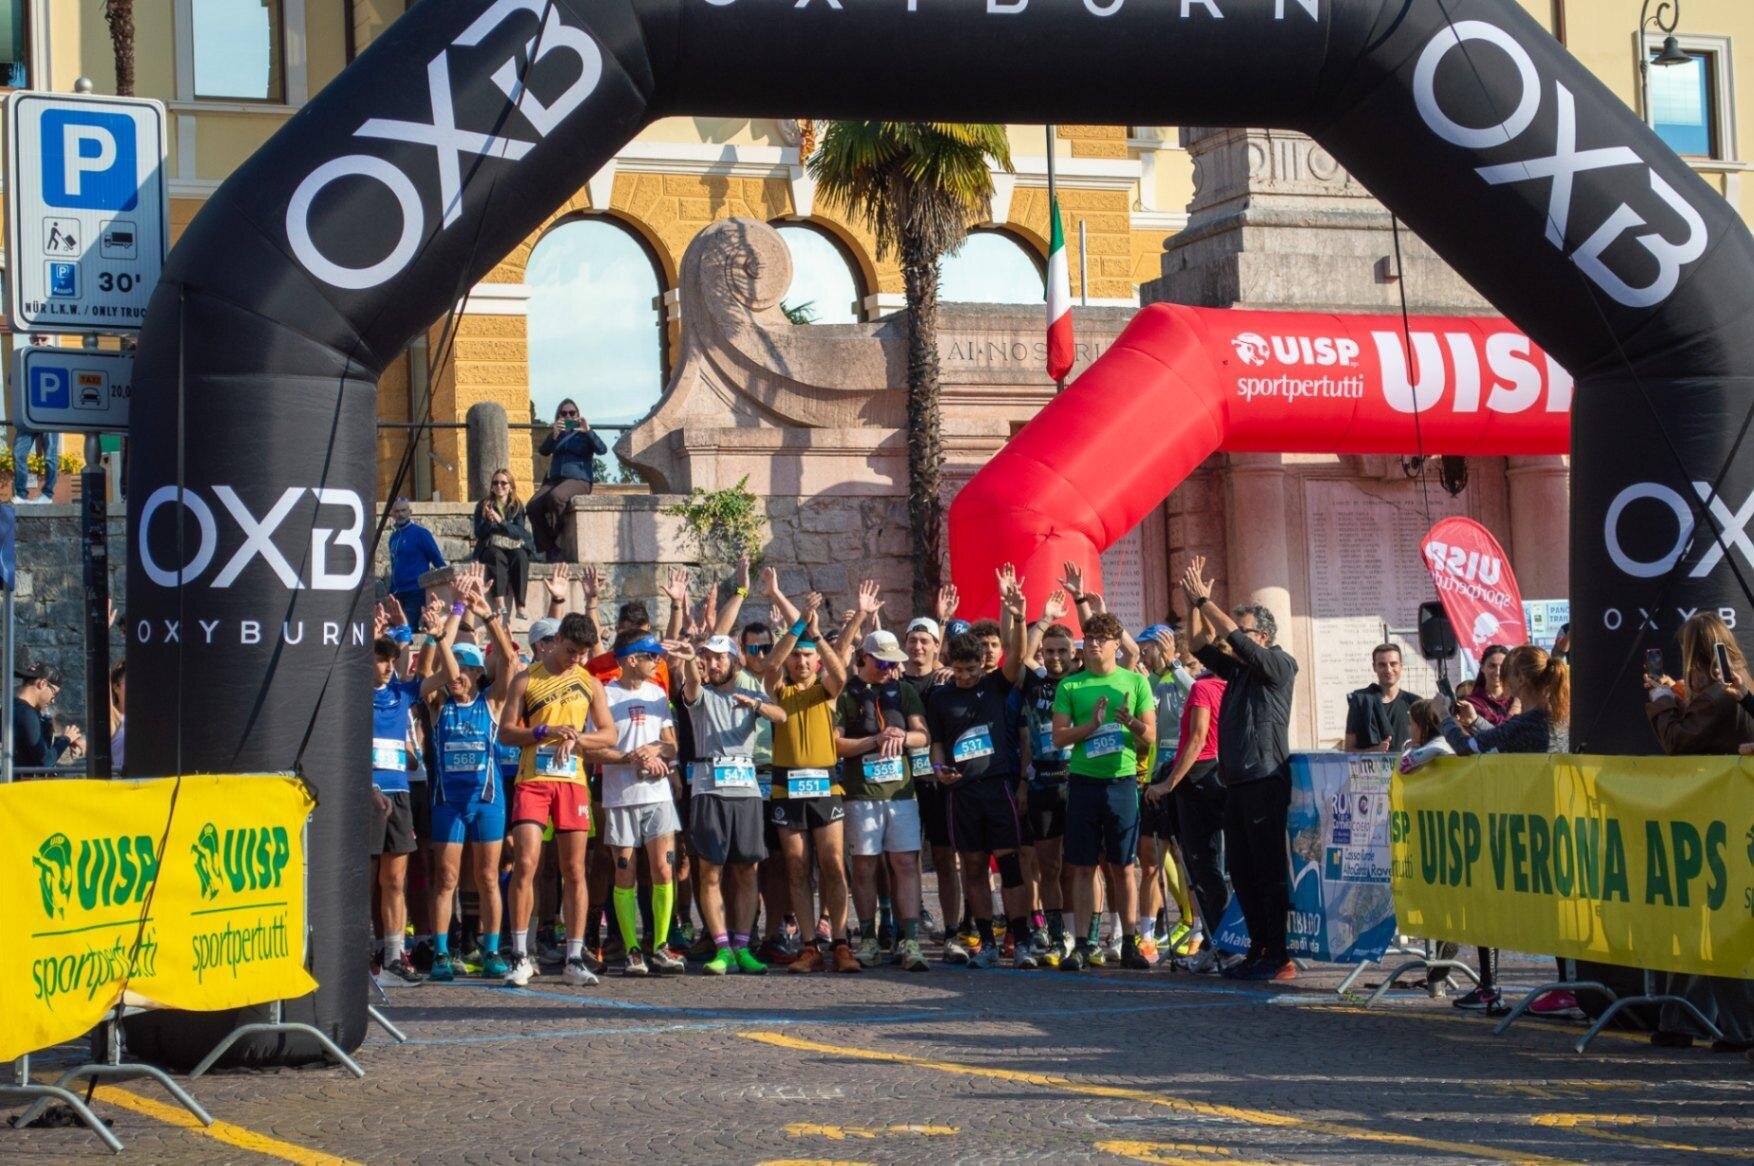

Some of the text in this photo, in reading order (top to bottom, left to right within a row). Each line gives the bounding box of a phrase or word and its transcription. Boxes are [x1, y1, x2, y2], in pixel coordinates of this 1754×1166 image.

[286, 0, 603, 289] OXB
[62, 123, 117, 197] P
[1413, 20, 1708, 308] OXB
[98, 271, 141, 293] 30'
[92, 306, 118, 317] ONLY
[1271, 335, 1360, 366] UISP
[40, 372, 61, 402] P
[1237, 373, 1364, 403] sportpertutti
[138, 485, 365, 590] OXB
[137, 619, 365, 647] OXYBURN
[961, 738, 982, 753] 537
[1093, 735, 1116, 748] 505
[453, 753, 476, 765] 568
[798, 780, 820, 791] 551
[77, 835, 159, 911] UISP
[223, 826, 290, 894] UISP
[1417, 809, 1729, 911] UISP VERONA APS
[192, 910, 289, 985] sportpertutti
